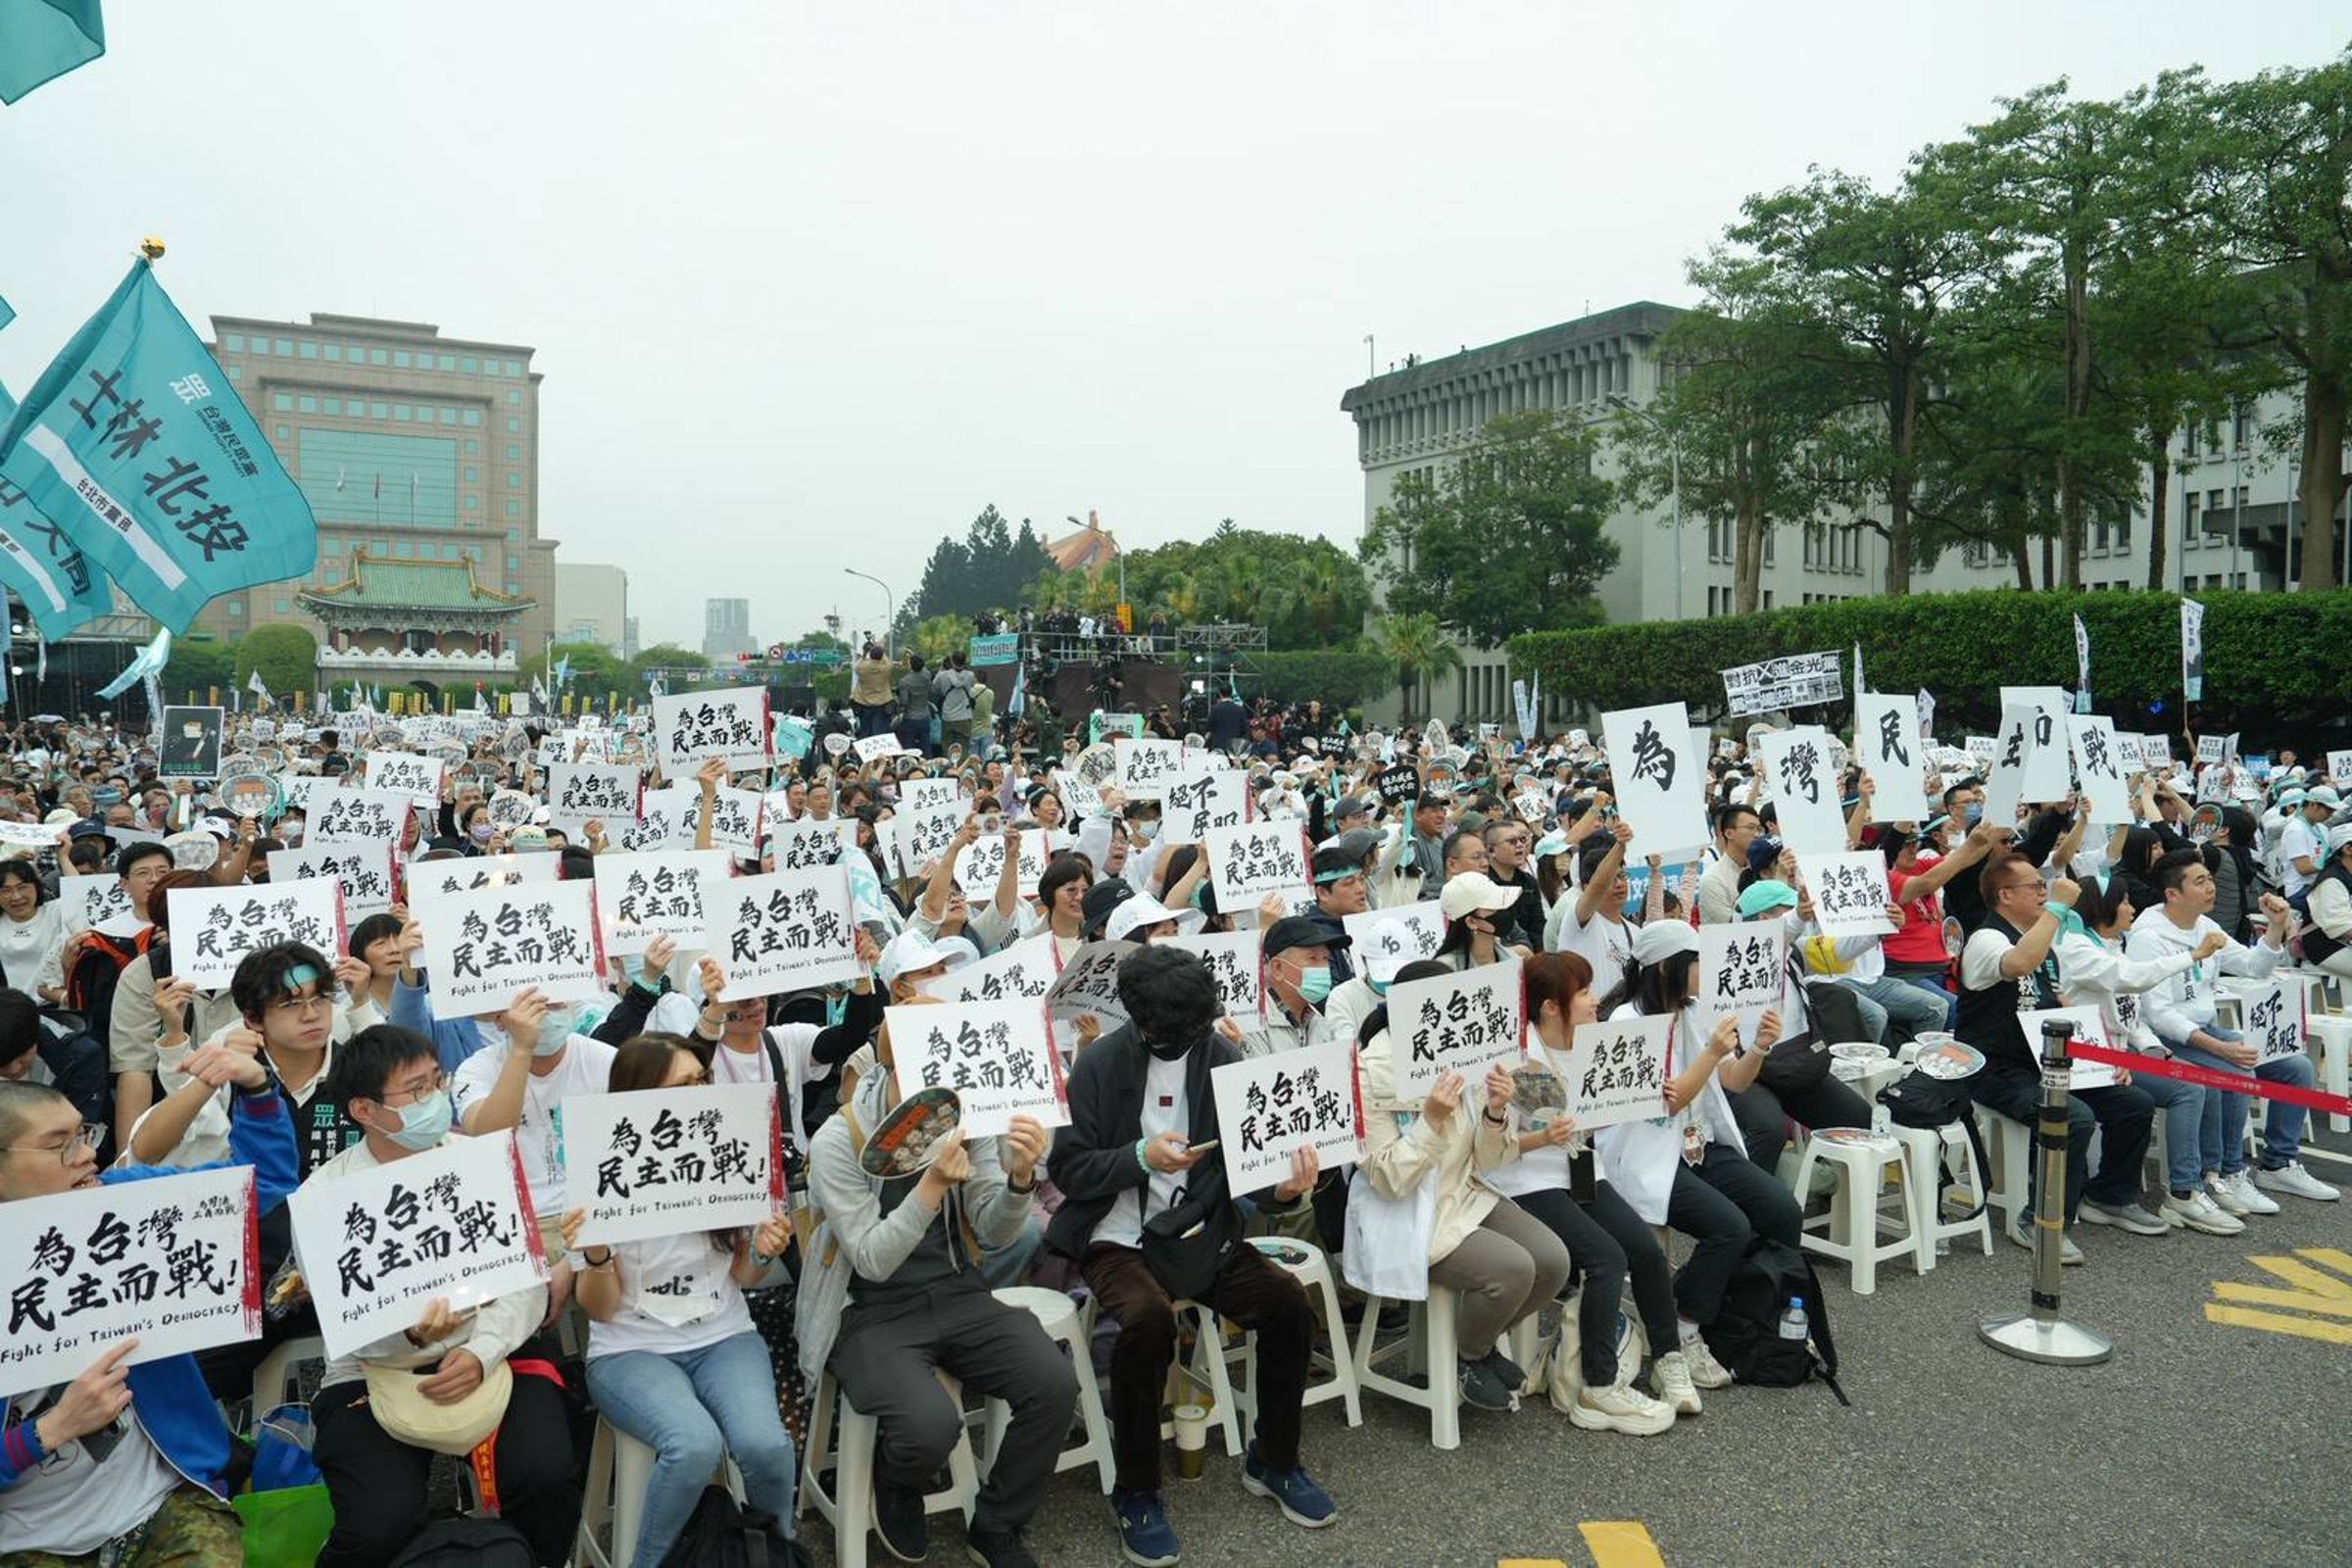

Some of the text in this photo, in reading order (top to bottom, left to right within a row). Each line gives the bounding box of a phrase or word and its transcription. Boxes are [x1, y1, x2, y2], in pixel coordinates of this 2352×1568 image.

[202, 406, 260, 477] 台灣民眾黨
[69, 369, 250, 563] 士林 北投
[76, 477, 133, 533] 台北市黨部
[678, 703, 738, 730] 為台灣
[672, 719, 761, 754] 民主而戰!
[1880, 710, 1909, 767] 民
[2082, 725, 2119, 780] 戰
[384, 760, 424, 779] 為台灣
[1131, 748, 1169, 765] 為台灣
[1633, 720, 1676, 792] 為
[1780, 741, 1819, 804] 灣
[568, 773, 618, 793] 為台灣
[1168, 776, 1218, 810] 絕不
[329, 798, 385, 820] 為台灣
[562, 791, 636, 811] 民主而戰!
[318, 815, 400, 842] 民主而戰!
[682, 809, 756, 841] 民而戰!
[793, 831, 841, 851] 為台灣
[915, 812, 957, 837] 為台灣
[1229, 834, 1281, 862] 為台灣
[297, 855, 363, 880] 為台灣
[627, 865, 700, 897] 為台灣
[967, 855, 1045, 883] 民主戰!
[1225, 852, 1303, 886] 民主而戰!
[1822, 864, 1869, 891] 為台灣
[86, 883, 126, 906] 為台
[739, 886, 819, 929] 為台灣
[1821, 882, 1889, 913] 民主而戰!
[207, 897, 298, 930] 為台灣
[460, 901, 554, 944] 為台灣
[196, 915, 333, 958] 民主而戰!
[452, 925, 590, 978] 民主而戰!
[731, 909, 852, 963] 民主而戰!
[1725, 935, 1774, 968] 為台灣
[193, 962, 217, 972] Fight
[451, 985, 476, 997] Fight
[482, 982, 498, 992] for
[548, 970, 595, 983] Democracy
[730, 952, 856, 981] Fight for Taiwan's Democracy
[1419, 984, 1494, 1029] 為台灣
[2249, 989, 2283, 1032] 絕不
[928, 1020, 1009, 1063] 為台灣
[1412, 1005, 1518, 1063] 民主而戰!
[1592, 1034, 1645, 1068] 為台灣
[2267, 1022, 2301, 1057] 屈服
[921, 1047, 1050, 1091] 民主而戰!
[1410, 1066, 1431, 1080] Fight
[1581, 1054, 1664, 1099] 民主而戰!
[1247, 1066, 1320, 1116] 為台灣
[608, 1107, 724, 1158] 為台灣
[1240, 1090, 1350, 1153] 民主而戰!
[597, 1138, 766, 1199] 民主而戰!
[1241, 1159, 1260, 1173] Fight
[343, 1171, 463, 1246] 為台灣
[593, 1190, 768, 1221] Fight for Taiwan's Democracy
[27, 1204, 184, 1277] 為台灣
[337, 1200, 519, 1298] 民主而戰!
[8, 1239, 238, 1336] 民主而戰!
[342, 1250, 528, 1324] Fight for Taiwan's Democracy
[0, 1301, 240, 1364] Fight for Taiwan's Democracy
